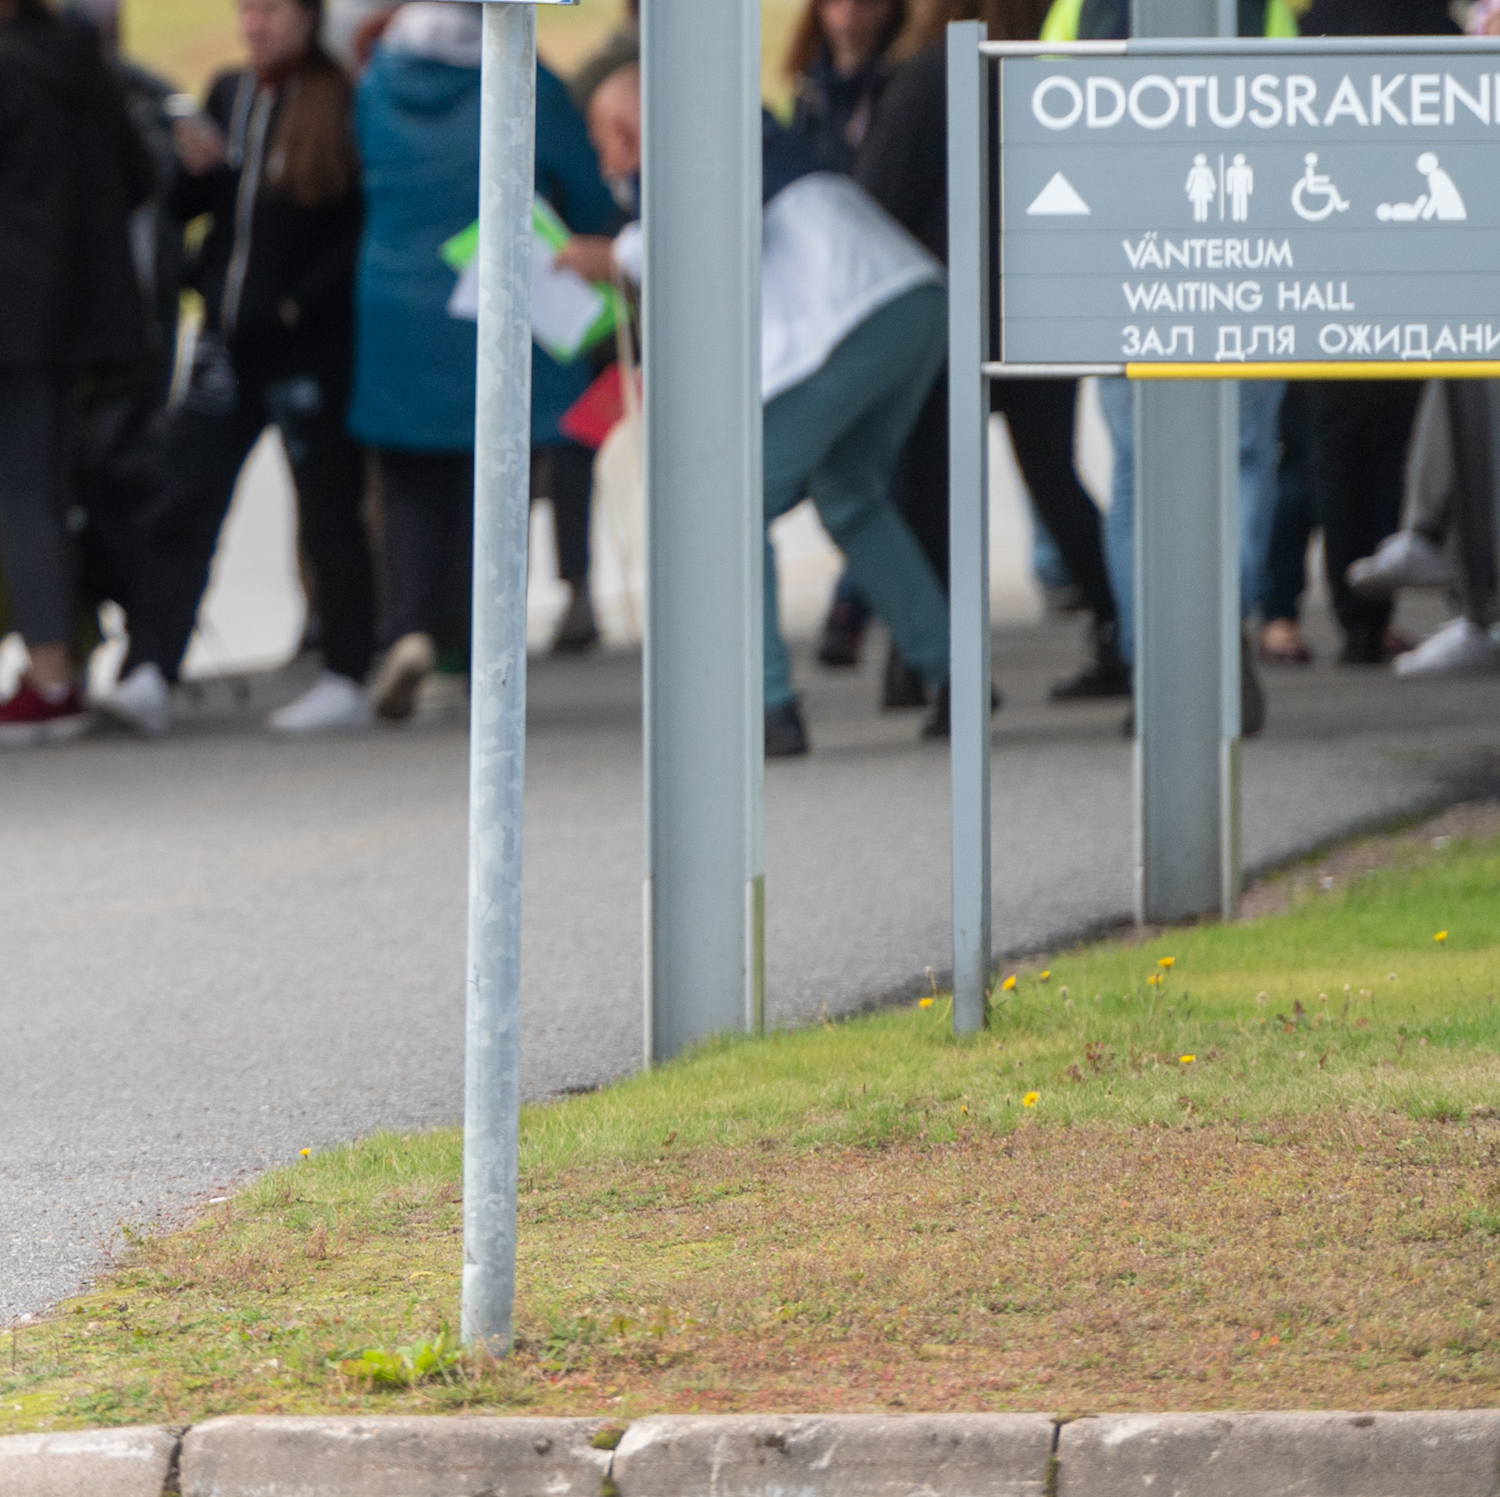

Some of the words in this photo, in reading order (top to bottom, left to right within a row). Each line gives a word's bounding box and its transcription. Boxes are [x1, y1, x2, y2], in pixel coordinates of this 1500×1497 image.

[1031, 72, 1500, 130] ODOTUSRAKEN
[1122, 230, 1294, 270] VÄNTERUM
[1122, 280, 1264, 313] WAITING
[1277, 280, 1356, 312] HALL
[1121, 324, 1194, 356] ЗАЛ
[1214, 324, 1296, 362] ДЛЯ
